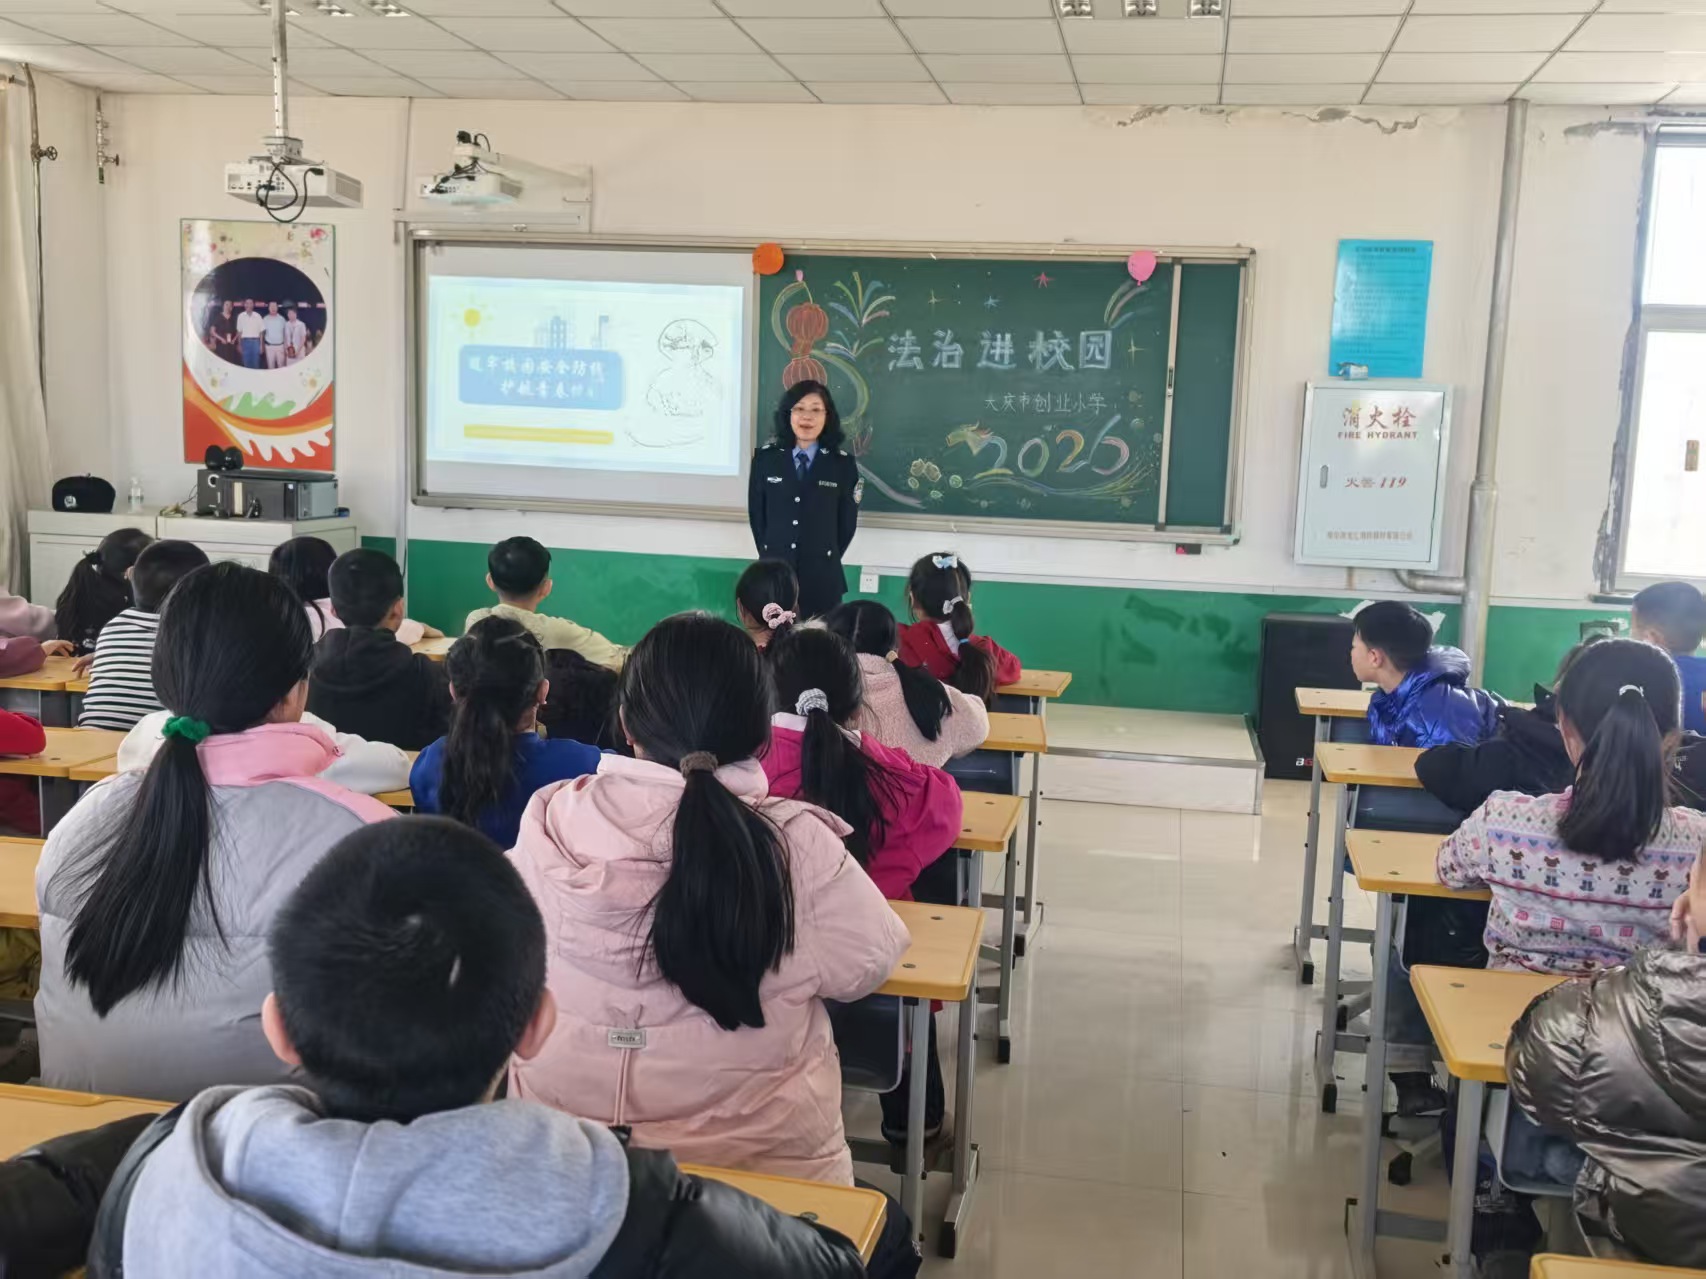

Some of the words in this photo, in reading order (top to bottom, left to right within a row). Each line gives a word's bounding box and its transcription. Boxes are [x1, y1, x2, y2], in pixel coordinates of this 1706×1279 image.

[887, 328, 1113, 371] 法治进校园
[984, 392, 1108, 415] 大庆市创业小学
[1343, 405, 1417, 429] 消火栓
[958, 414, 1130, 477] 2026
[1337, 431, 1361, 439] FIRE
[1367, 431, 1418, 439] HYDRANT
[1379, 476, 1408, 488] 119
